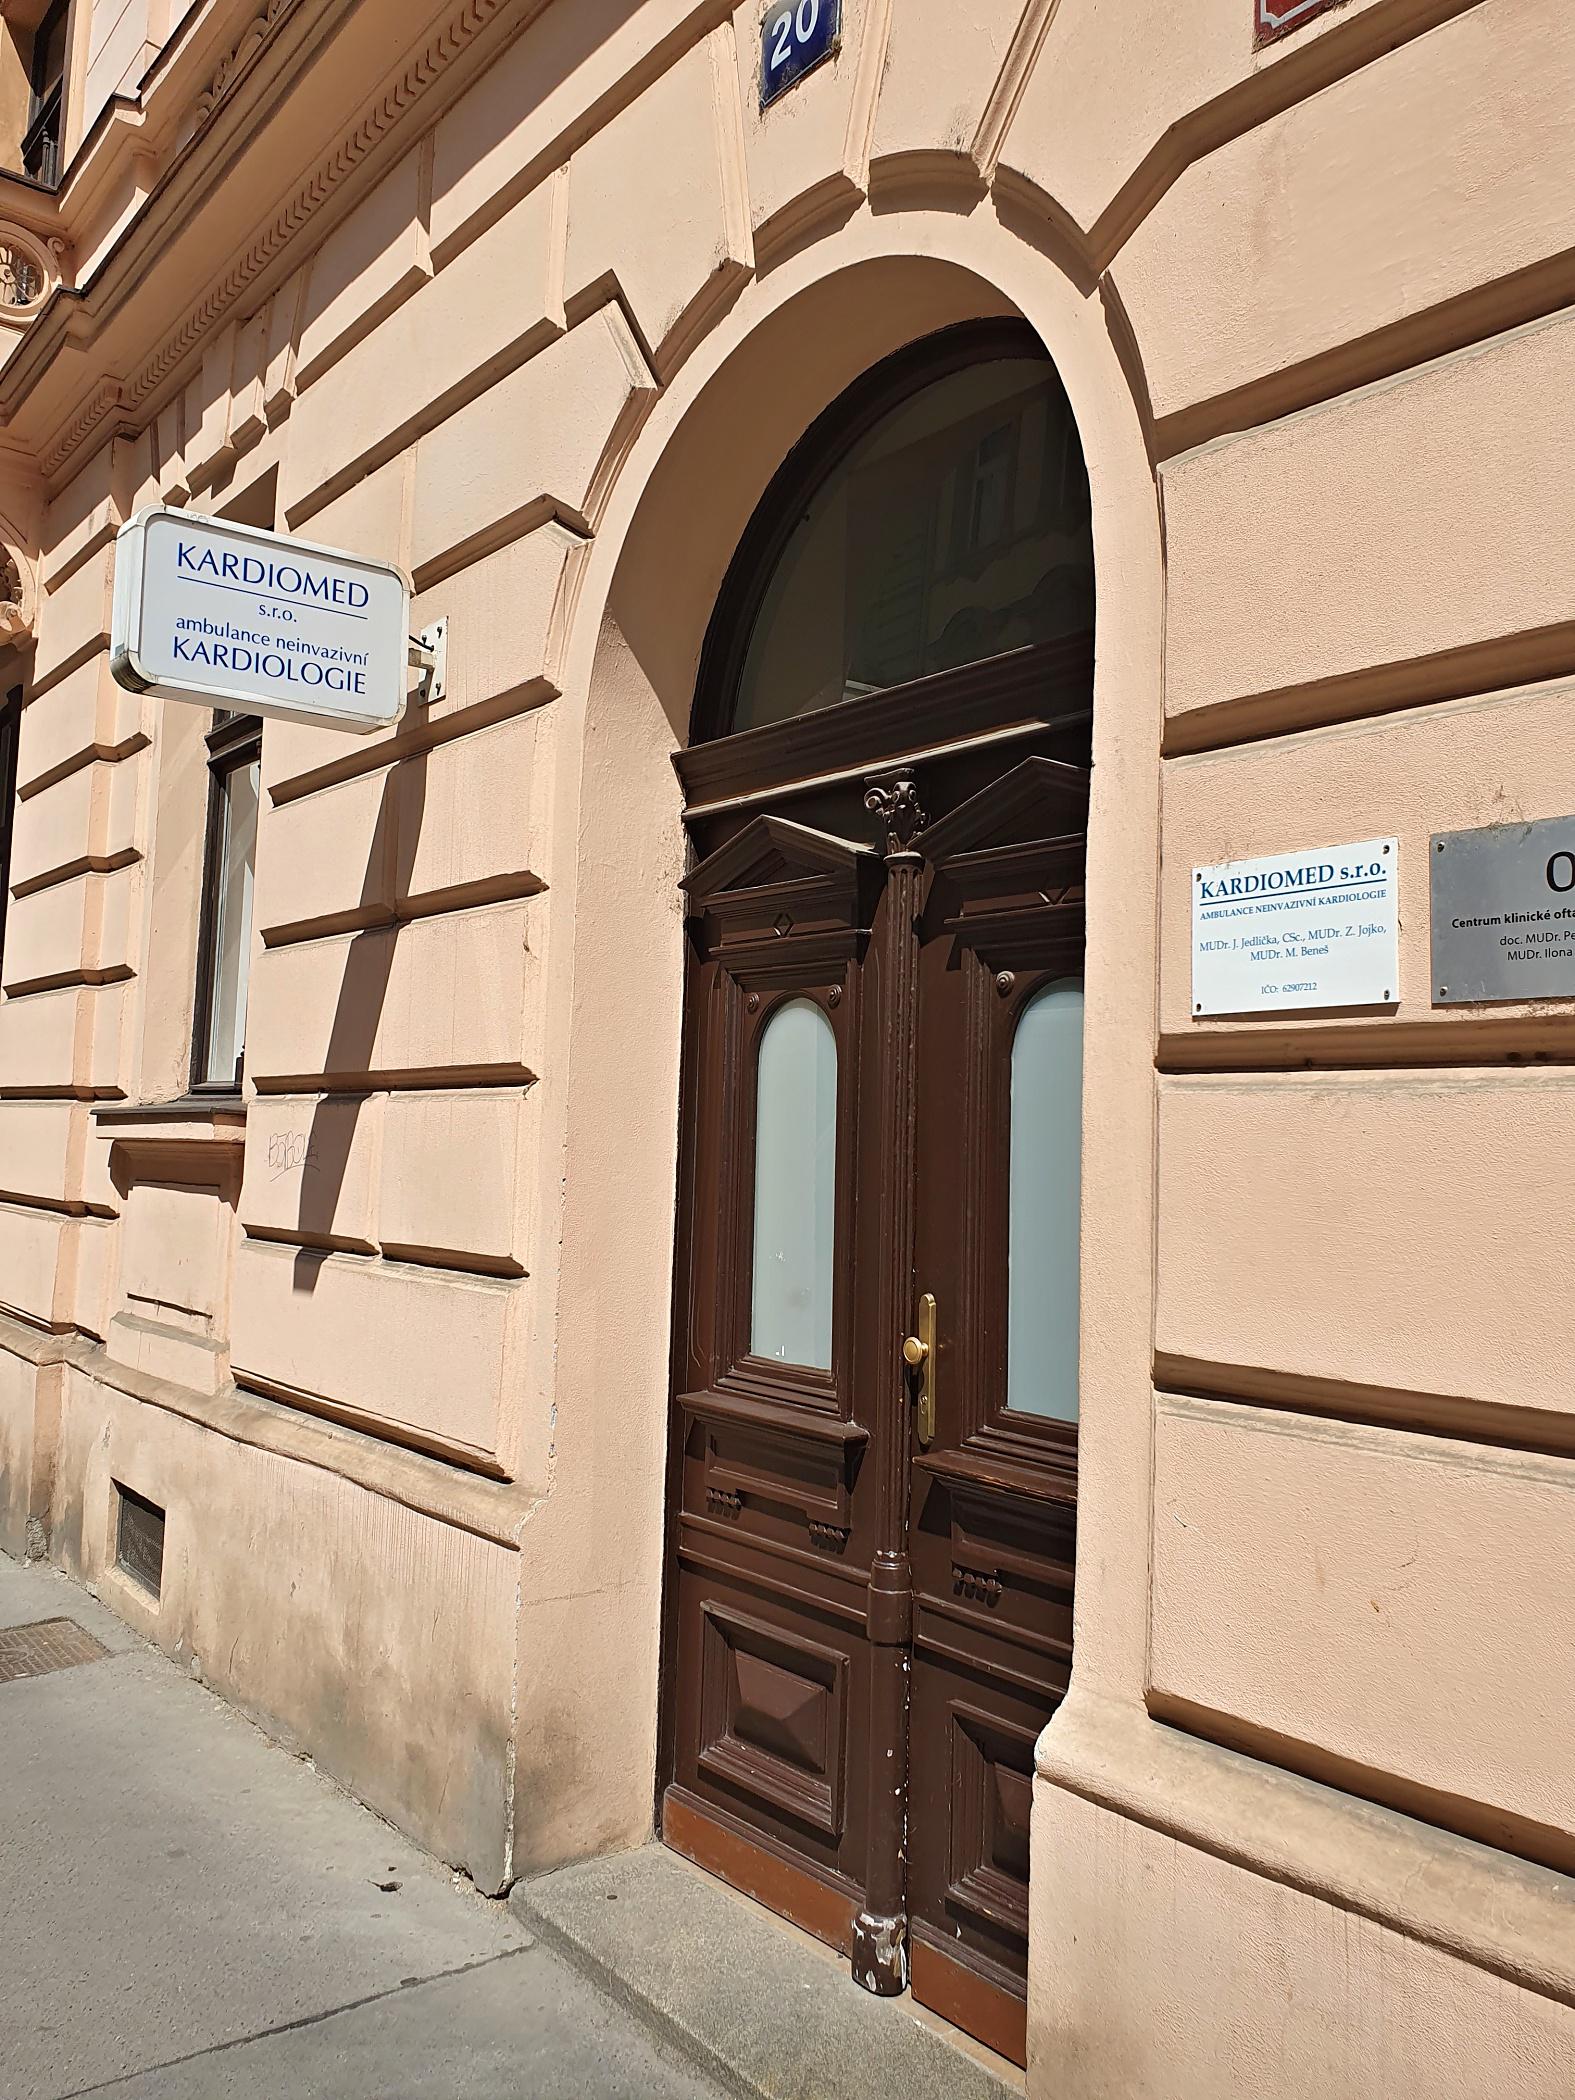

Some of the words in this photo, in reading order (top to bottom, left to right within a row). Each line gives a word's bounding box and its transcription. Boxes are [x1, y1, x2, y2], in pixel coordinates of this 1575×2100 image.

[771, 0, 819, 71] 20
[177, 542, 369, 608] KARDIOMED
[259, 605, 297, 623] s.r.o.
[176, 616, 270, 646] ambulance
[276, 636, 369, 667] neinvazivní
[173, 636, 366, 695] KARDIOLOGIE
[1200, 864, 1334, 899] KARDIOMED
[1340, 862, 1386, 880] s.r.o.
[1200, 905, 1254, 920] AMBULANCE
[1255, 896, 1317, 913] NEINVAZIVNÍ
[1318, 889, 1387, 906] KARDIOLOGIE
[1451, 917, 1501, 929] Centrum
[1504, 909, 1551, 924] klinické
[1200, 940, 1231, 951] MUDr.
[1232, 939, 1239, 950] J.
[1241, 935, 1280, 949] Jedlička,
[1282, 932, 1306, 943] CSc.,
[1308, 927, 1343, 940] MUDr.
[1345, 926, 1356, 937] Z.
[1357, 923, 1387, 937] Jojko,
[1500, 936, 1523, 945] doc.
[1525, 932, 1561, 944] MUDr.
[1250, 949, 1283, 961] MUDr.
[1285, 947, 1298, 957] M.
[1301, 945, 1329, 956] Beneš
[1507, 950, 1542, 961] MUDr.
[1545, 948, 1573, 958] Ilona
[1261, 984, 1279, 994] IČO:
